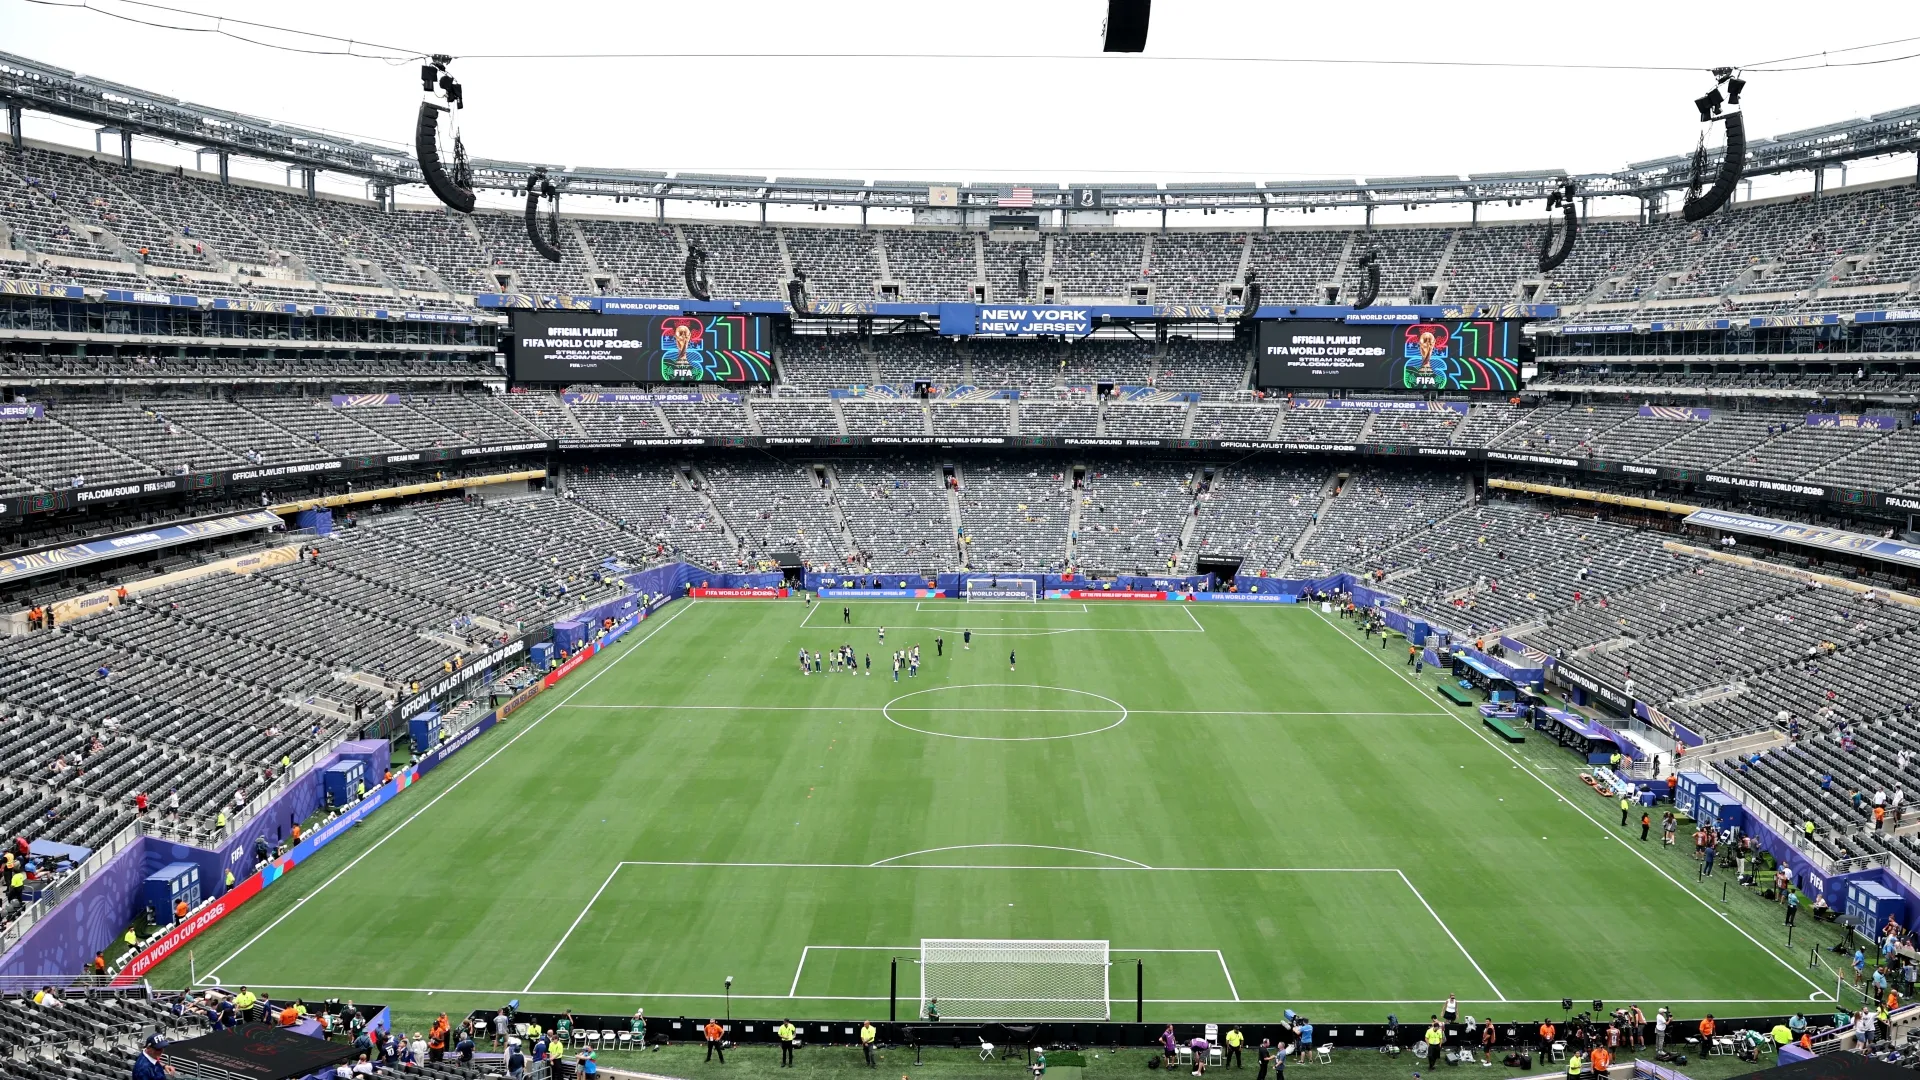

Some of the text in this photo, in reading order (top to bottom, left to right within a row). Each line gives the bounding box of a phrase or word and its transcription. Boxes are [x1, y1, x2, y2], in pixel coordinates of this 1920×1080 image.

[982, 310, 1086, 320] NEW YORK
[548, 328, 618, 337] OFFICIAL PLAYLIST
[982, 322, 1086, 332] NEW JERSEY
[522, 338, 545, 348] FIFA
[546, 339, 583, 348] WORLD
[584, 340, 604, 348] CUP
[1292, 336, 1361, 344] OFFICIAL PLAYLIST
[1267, 346, 1288, 354] FIFA
[1290, 347, 1324, 355] WORLD
[1325, 347, 1346, 355] CUP
[1416, 376, 1436, 384] FIFA
[387, 453, 420, 463] STREAM NOW
[1508, 454, 1529, 462] PLAYLIST
[1538, 456, 1554, 464] WORLD
[232, 470, 258, 480] OFFICIAL
[258, 466, 286, 478] PLAYLIST
[286, 465, 298, 474] FIFA
[298, 464, 315, 472] WORLD
[1622, 465, 1644, 474] STREAM
[1706, 474, 1731, 485] OFFICIAL
[1731, 478, 1759, 488] PLAYLIST
[1760, 481, 1772, 490] FIFA
[1772, 482, 1792, 492] WORLD
[1792, 485, 1803, 493] CUP
[78, 485, 140, 502] FIFA.COM/SOUND
[144, 482, 157, 492] FIFA
[1710, 514, 1736, 524] WORLD
[1750, 520, 1776, 530] 2026
[1778, 566, 1791, 574] NEW
[1791, 570, 1812, 578] JERSEY
[401, 696, 430, 720] OFFICIAL
[430, 672, 462, 700] PLAYLIST
[462, 667, 474, 682] FIFA
[474, 655, 492, 674] WORLD
[492, 648, 504, 662] CUP
[1558, 666, 1599, 693] FIFA.COM/SOUND
[1601, 687, 1611, 700] FIFA
[231, 844, 244, 864] FIFA
[1810, 872, 1824, 892] FIFA
[132, 956, 150, 976] FIFA
[150, 933, 179, 964] WORLD
[180, 922, 196, 941] CUP
